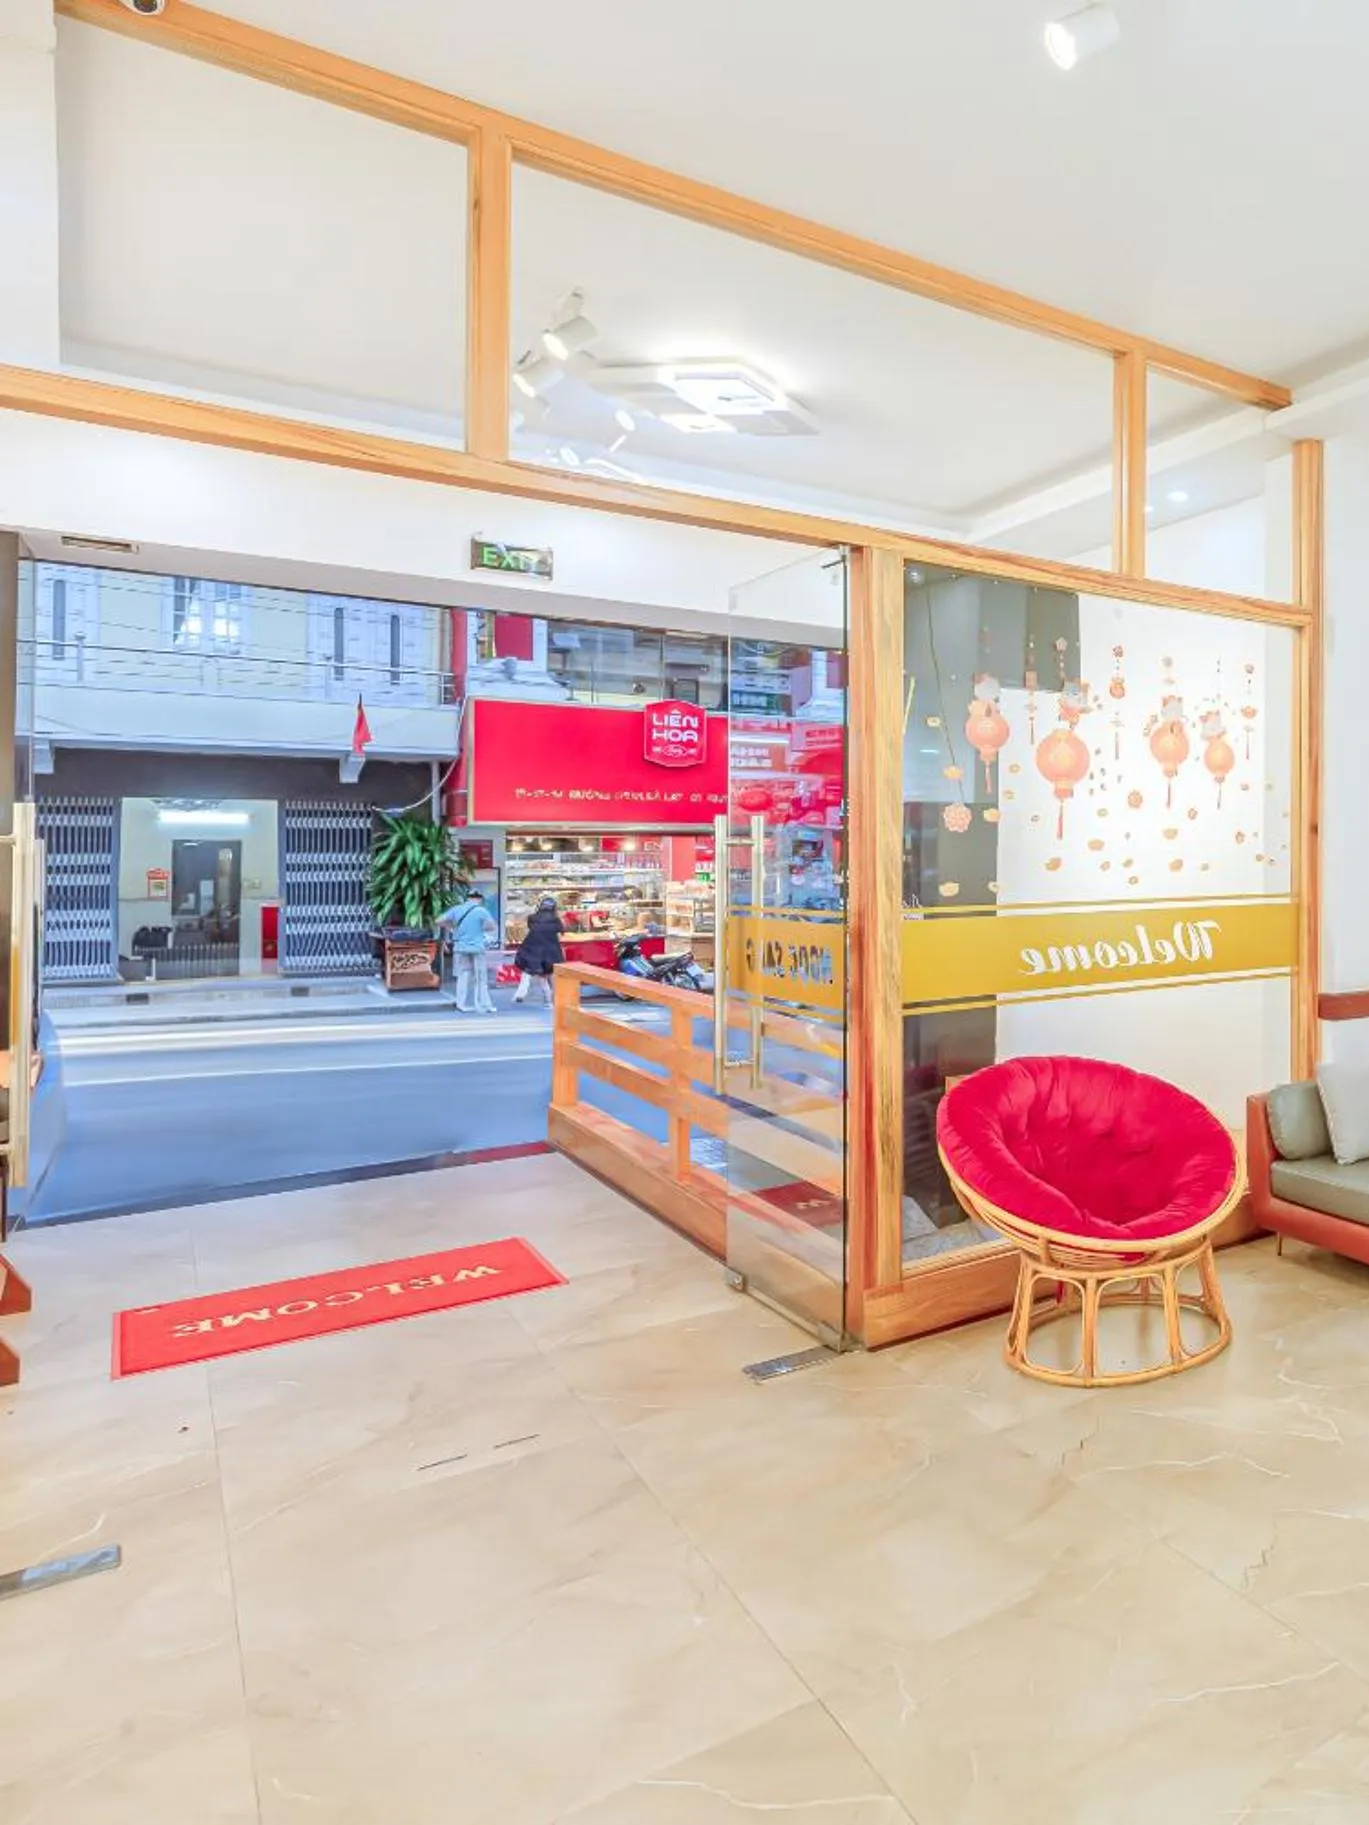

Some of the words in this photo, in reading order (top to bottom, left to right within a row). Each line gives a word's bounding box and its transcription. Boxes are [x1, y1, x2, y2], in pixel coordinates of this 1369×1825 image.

[652, 708, 699, 728] LIÊN
[652, 728, 699, 743] HOA
[173, 1264, 504, 1338] WELCOME
